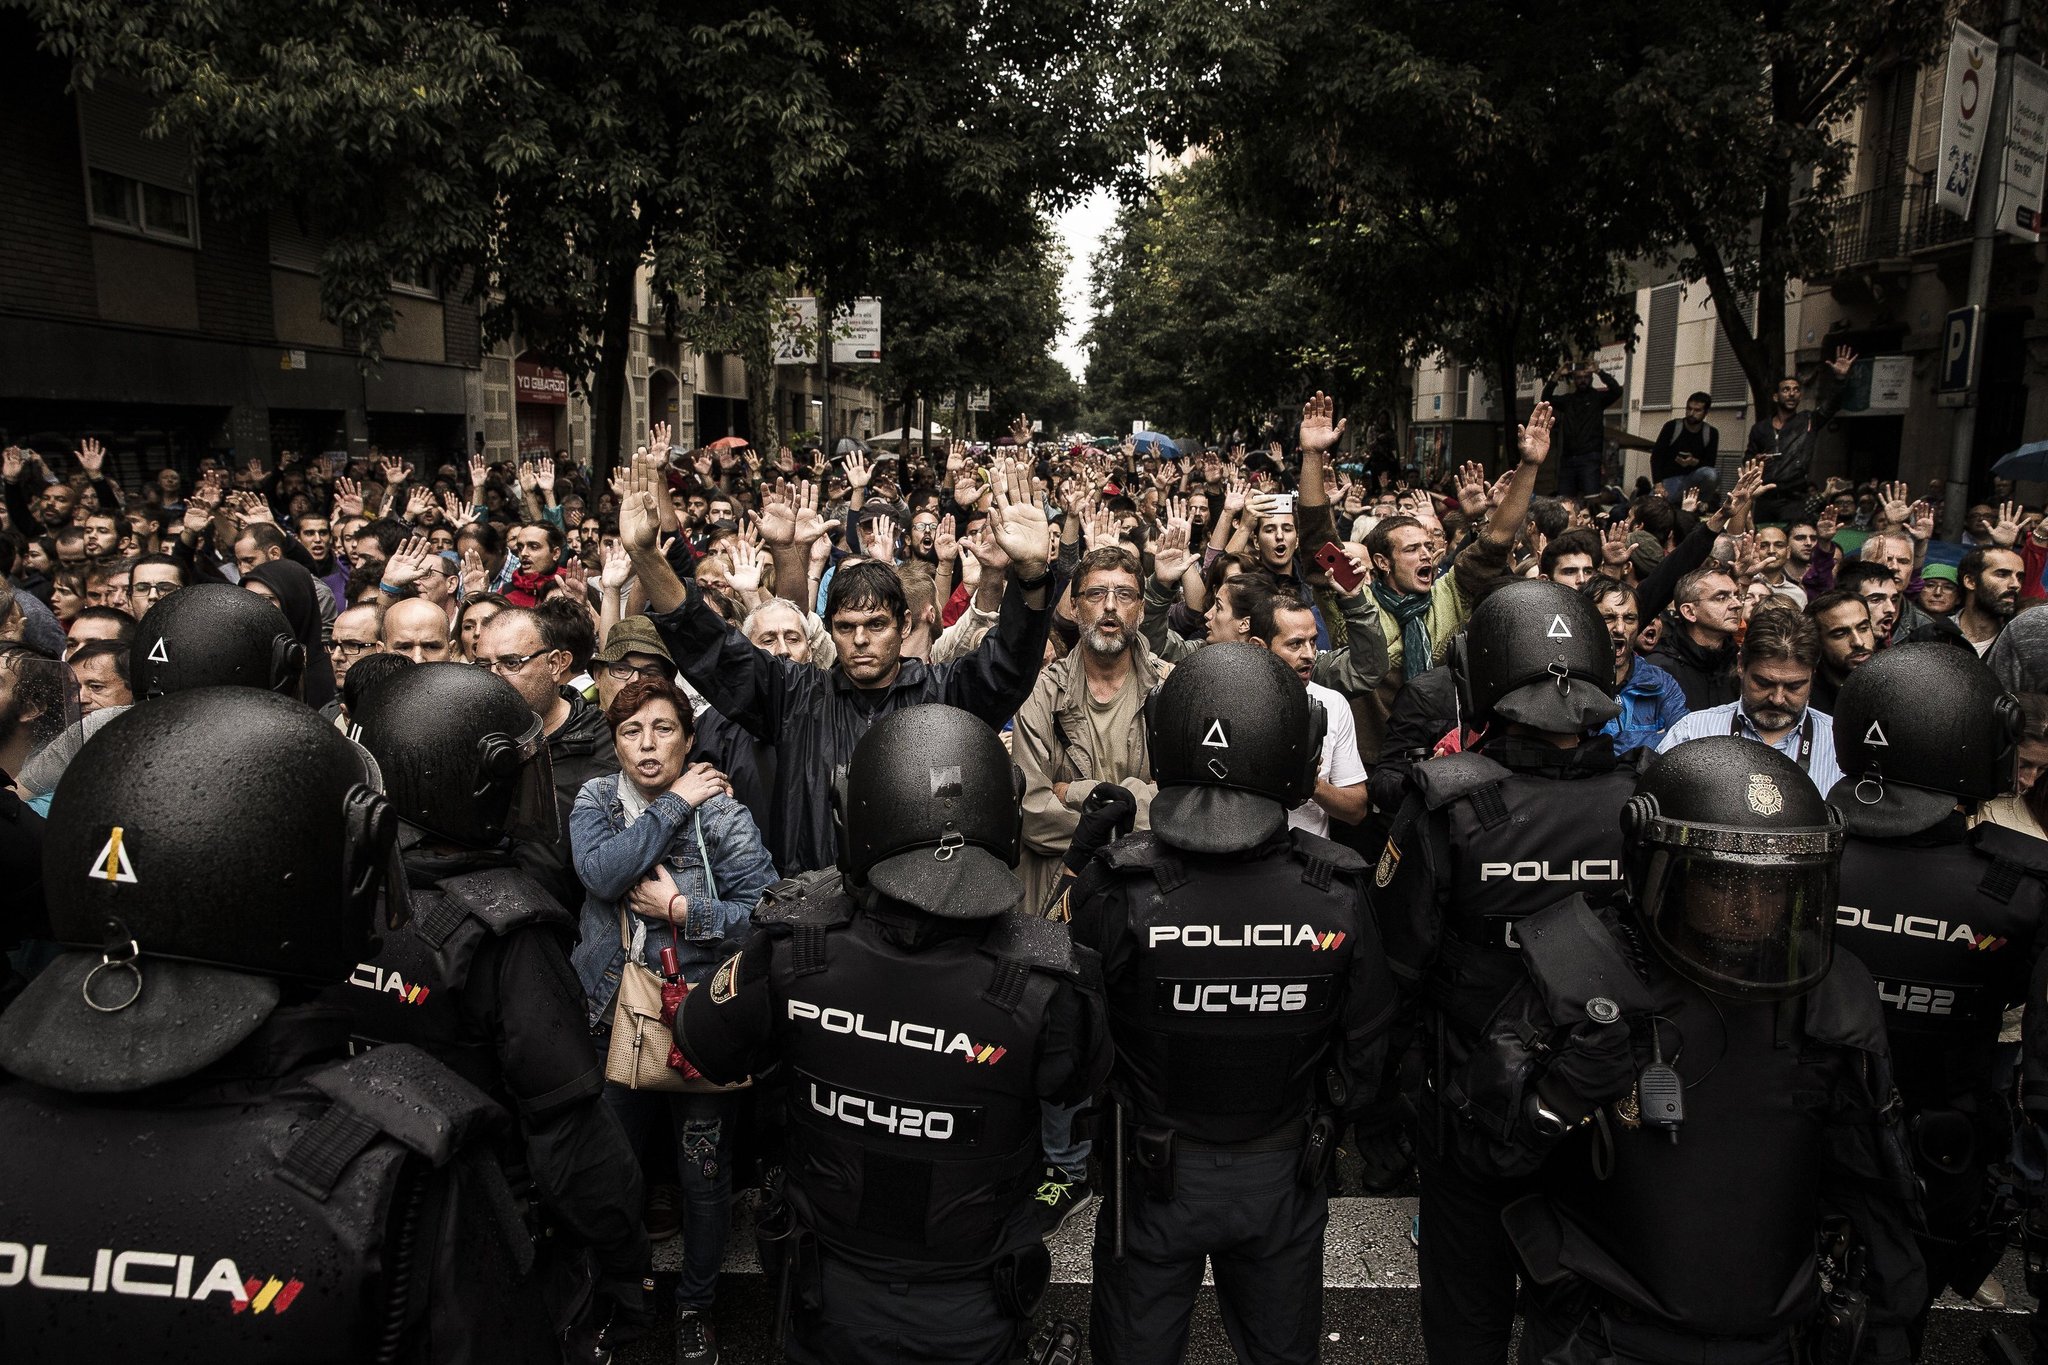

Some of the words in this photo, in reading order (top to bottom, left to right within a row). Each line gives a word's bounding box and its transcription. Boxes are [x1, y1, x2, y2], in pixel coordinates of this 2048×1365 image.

[1945, 318, 1967, 383] P
[517, 375, 530, 389] YO
[1481, 860, 1624, 881] POLICI
[1149, 924, 1320, 948] POLICIA
[344, 963, 407, 998] CIA
[1173, 984, 1308, 1012] UC426
[788, 999, 975, 1058] POLICIA
[811, 1083, 954, 1139] UC420
